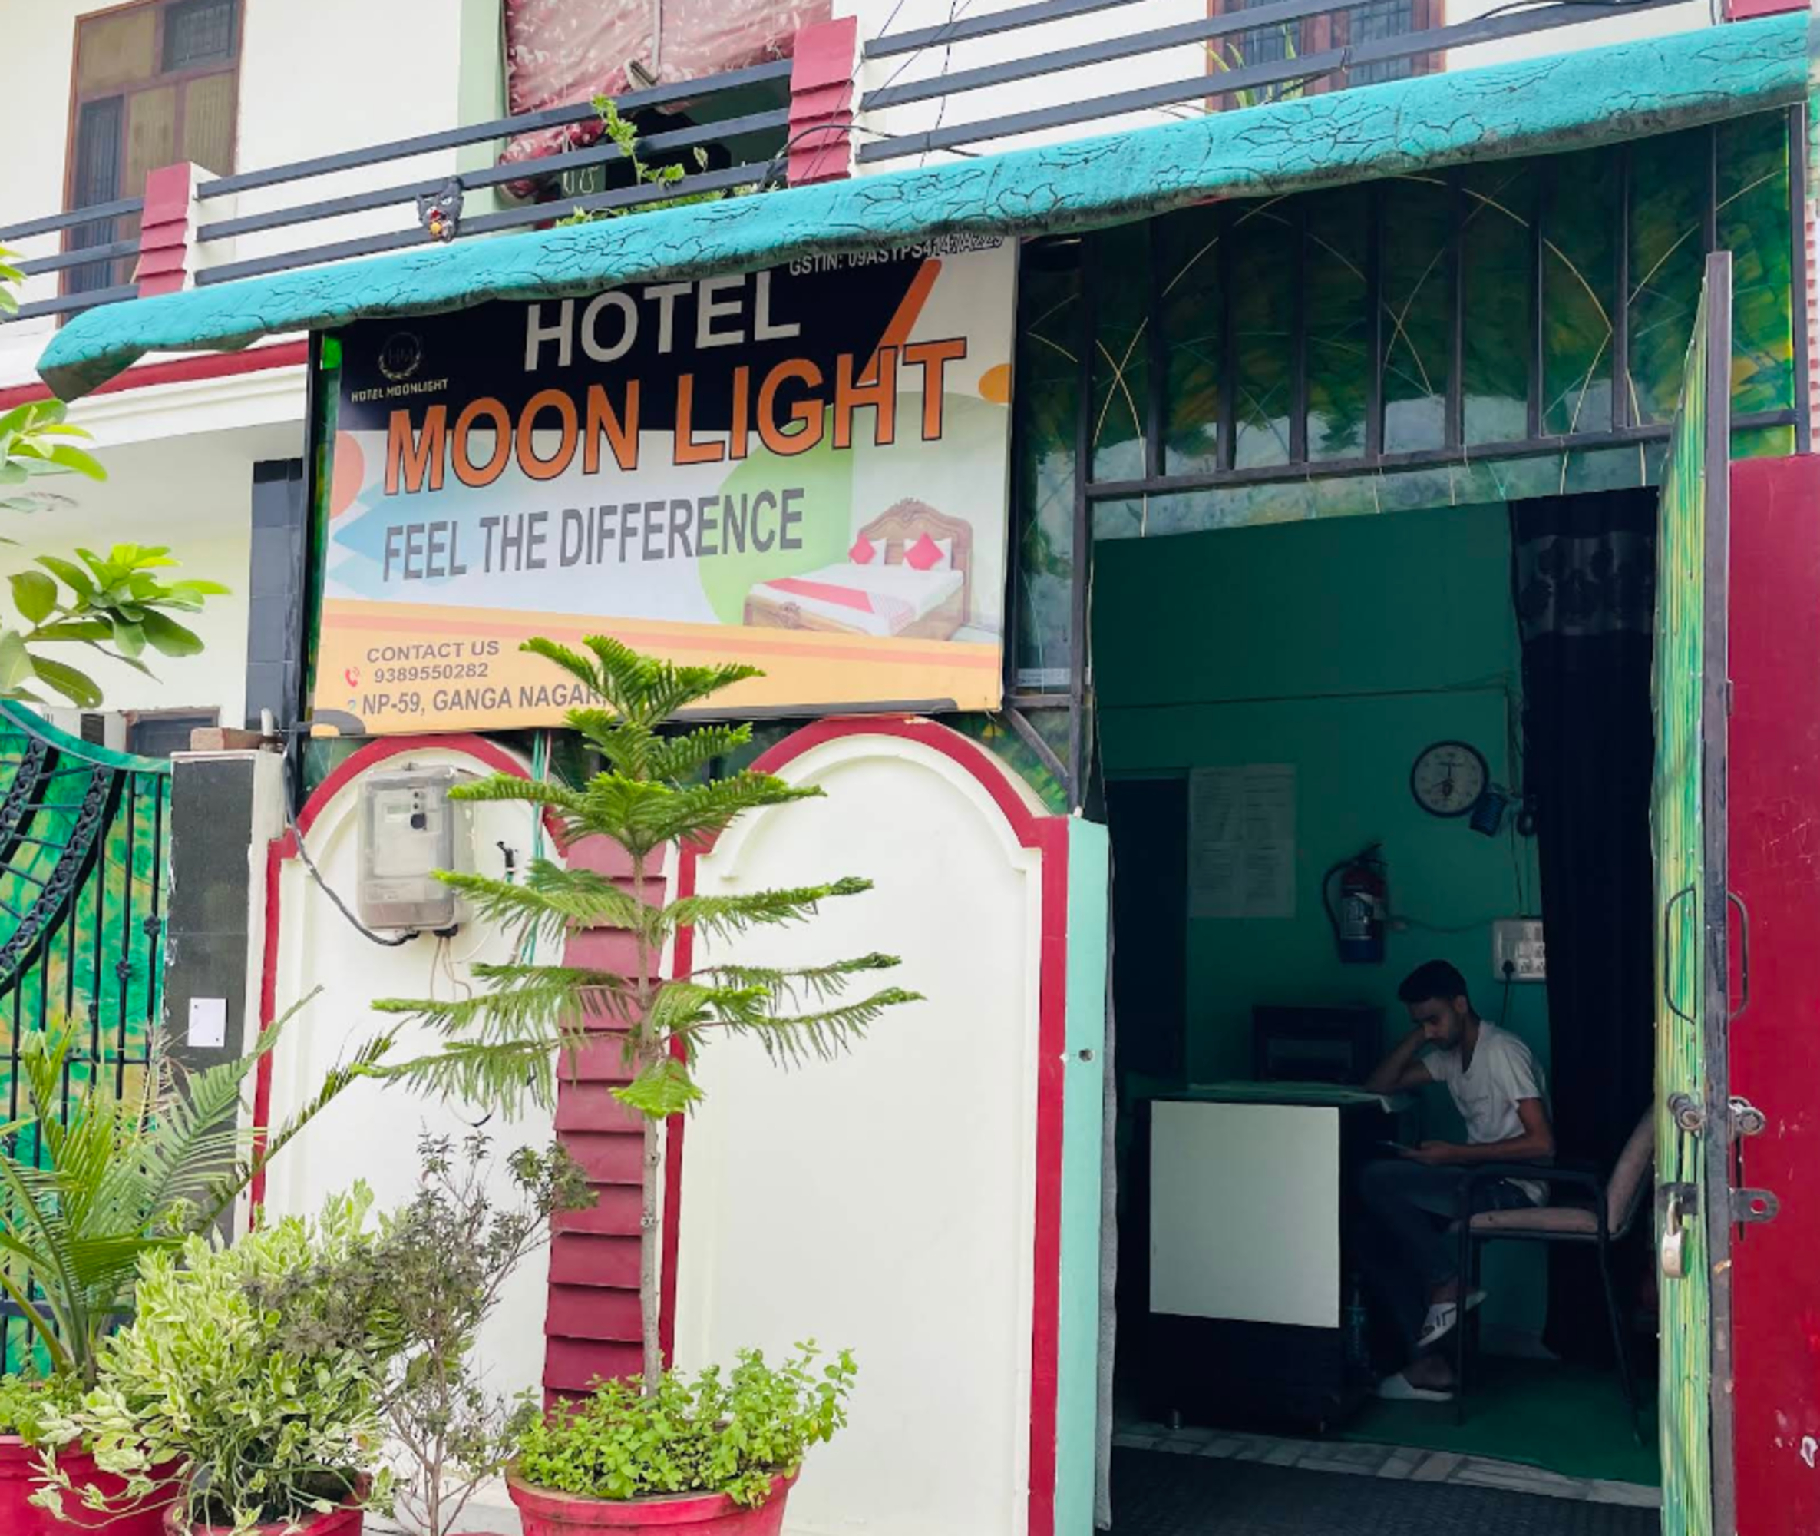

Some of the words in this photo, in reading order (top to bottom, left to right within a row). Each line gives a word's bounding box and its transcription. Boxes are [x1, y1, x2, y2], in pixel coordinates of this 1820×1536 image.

[788, 252, 844, 276] GSTIN:
[524, 270, 801, 371] HOTEL
[351, 388, 384, 403] HOTEL
[386, 378, 448, 398] MOONLIGHT
[384, 378, 641, 496] MOON
[672, 336, 968, 467] LIGHT
[383, 520, 468, 582] FEEL
[479, 510, 549, 573] THE
[559, 487, 805, 568] DIFFERENCE
[366, 642, 465, 664] CONTACT
[470, 640, 500, 656] US
[374, 662, 489, 684] 9389550282
[362, 691, 426, 717] NP-59,
[433, 686, 513, 712] GANGA
